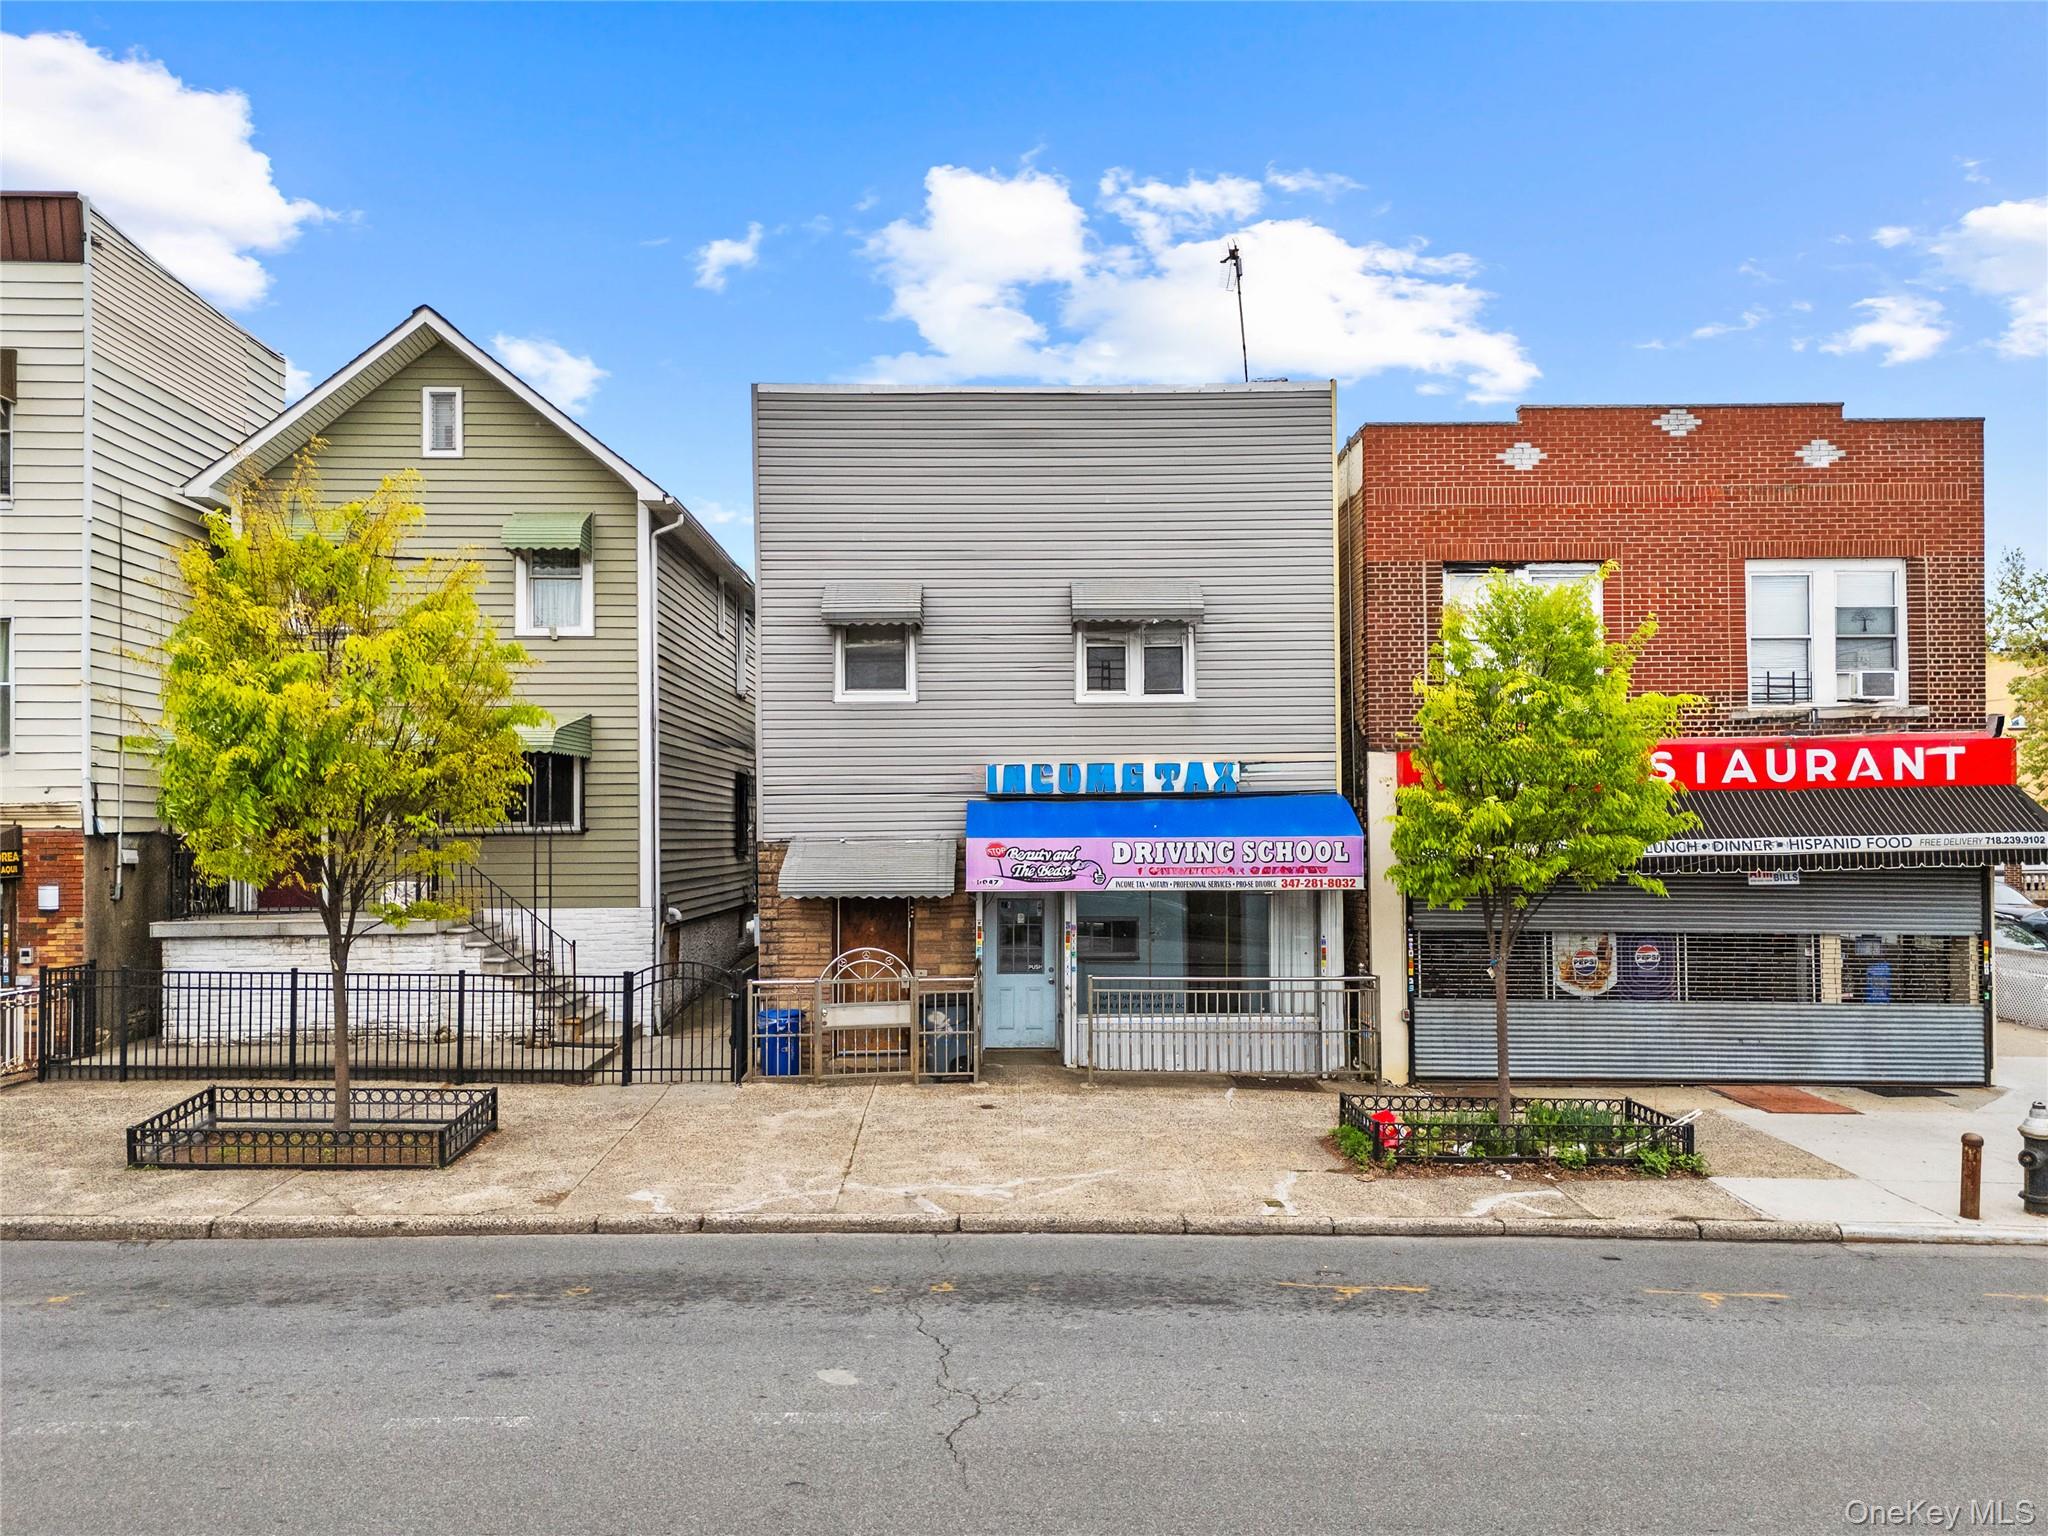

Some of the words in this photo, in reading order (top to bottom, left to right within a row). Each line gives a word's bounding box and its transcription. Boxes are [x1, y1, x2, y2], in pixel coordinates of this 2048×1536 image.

[986, 763, 1145, 793] INCOME
[1154, 761, 1239, 793] TAX
[986, 847, 1005, 857] STOP
[1112, 841, 1235, 864] DRIVING
[1241, 840, 1350, 864] SCHOOL
[1645, 841, 1698, 853] LUNCH
[1713, 839, 1773, 852] DINNER
[1789, 838, 1861, 850] HISPANID
[1867, 836, 1913, 849] FOOD
[1919, 838, 1942, 847] FREE
[1943, 837, 1983, 846] DELIVERY
[1985, 835, 2046, 845] 718.239.9102
[1006, 846, 1053, 862] Beauty
[1052, 845, 1081, 861] and
[1011, 863, 1035, 878] The
[1036, 863, 1073, 878] Beast
[1774, 872, 1798, 881] BILLS
[1115, 881, 1134, 889] INCOME
[1136, 881, 1145, 889] TAX
[1149, 881, 1169, 889] NOTARY
[1255, 880, 1277, 888] DIVORCE
[1281, 878, 1357, 889] 347-281-8032
